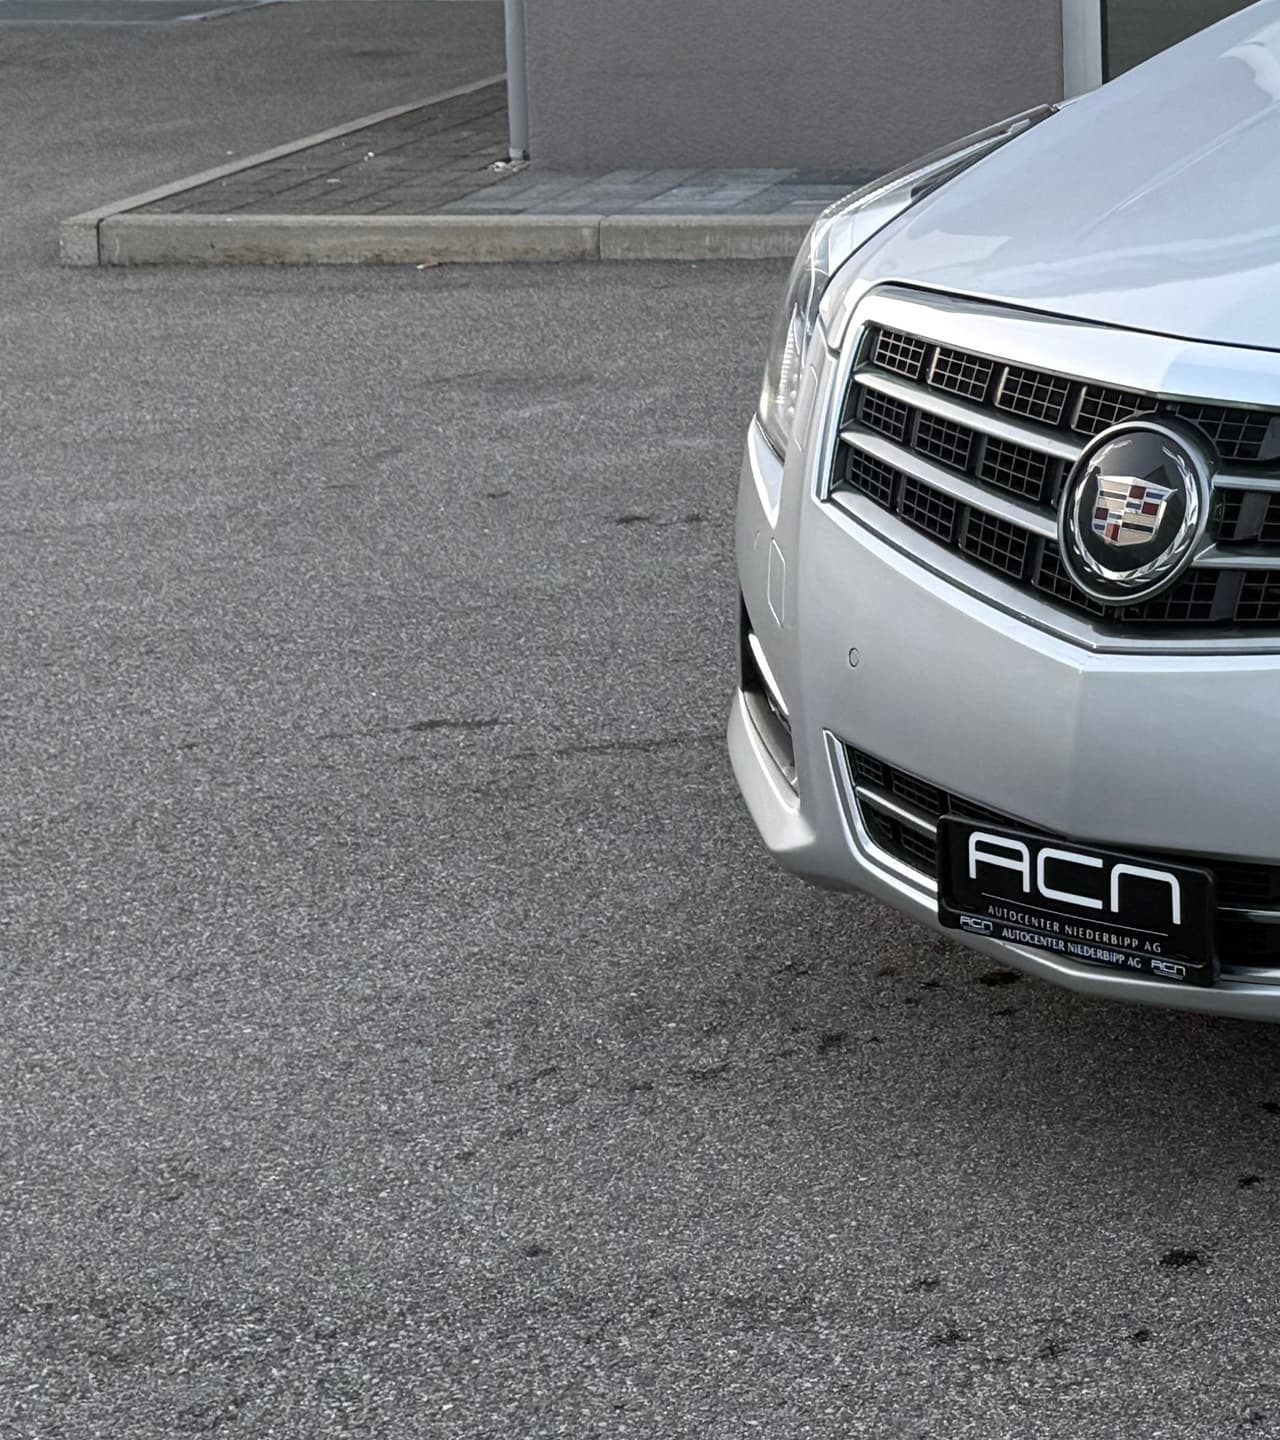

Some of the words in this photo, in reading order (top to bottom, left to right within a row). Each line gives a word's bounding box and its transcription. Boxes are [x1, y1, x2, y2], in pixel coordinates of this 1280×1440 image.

[969, 831, 1181, 925] ACN
[988, 905, 1060, 933] AUTOCENTER
[1064, 926, 1139, 948] NIEDERBIPP
[1144, 941, 1162, 953] AG
[1002, 928, 1065, 951] AUTOCENTER
[1067, 943, 1125, 964] NIEDERBIPP
[1127, 958, 1142, 969] AG
